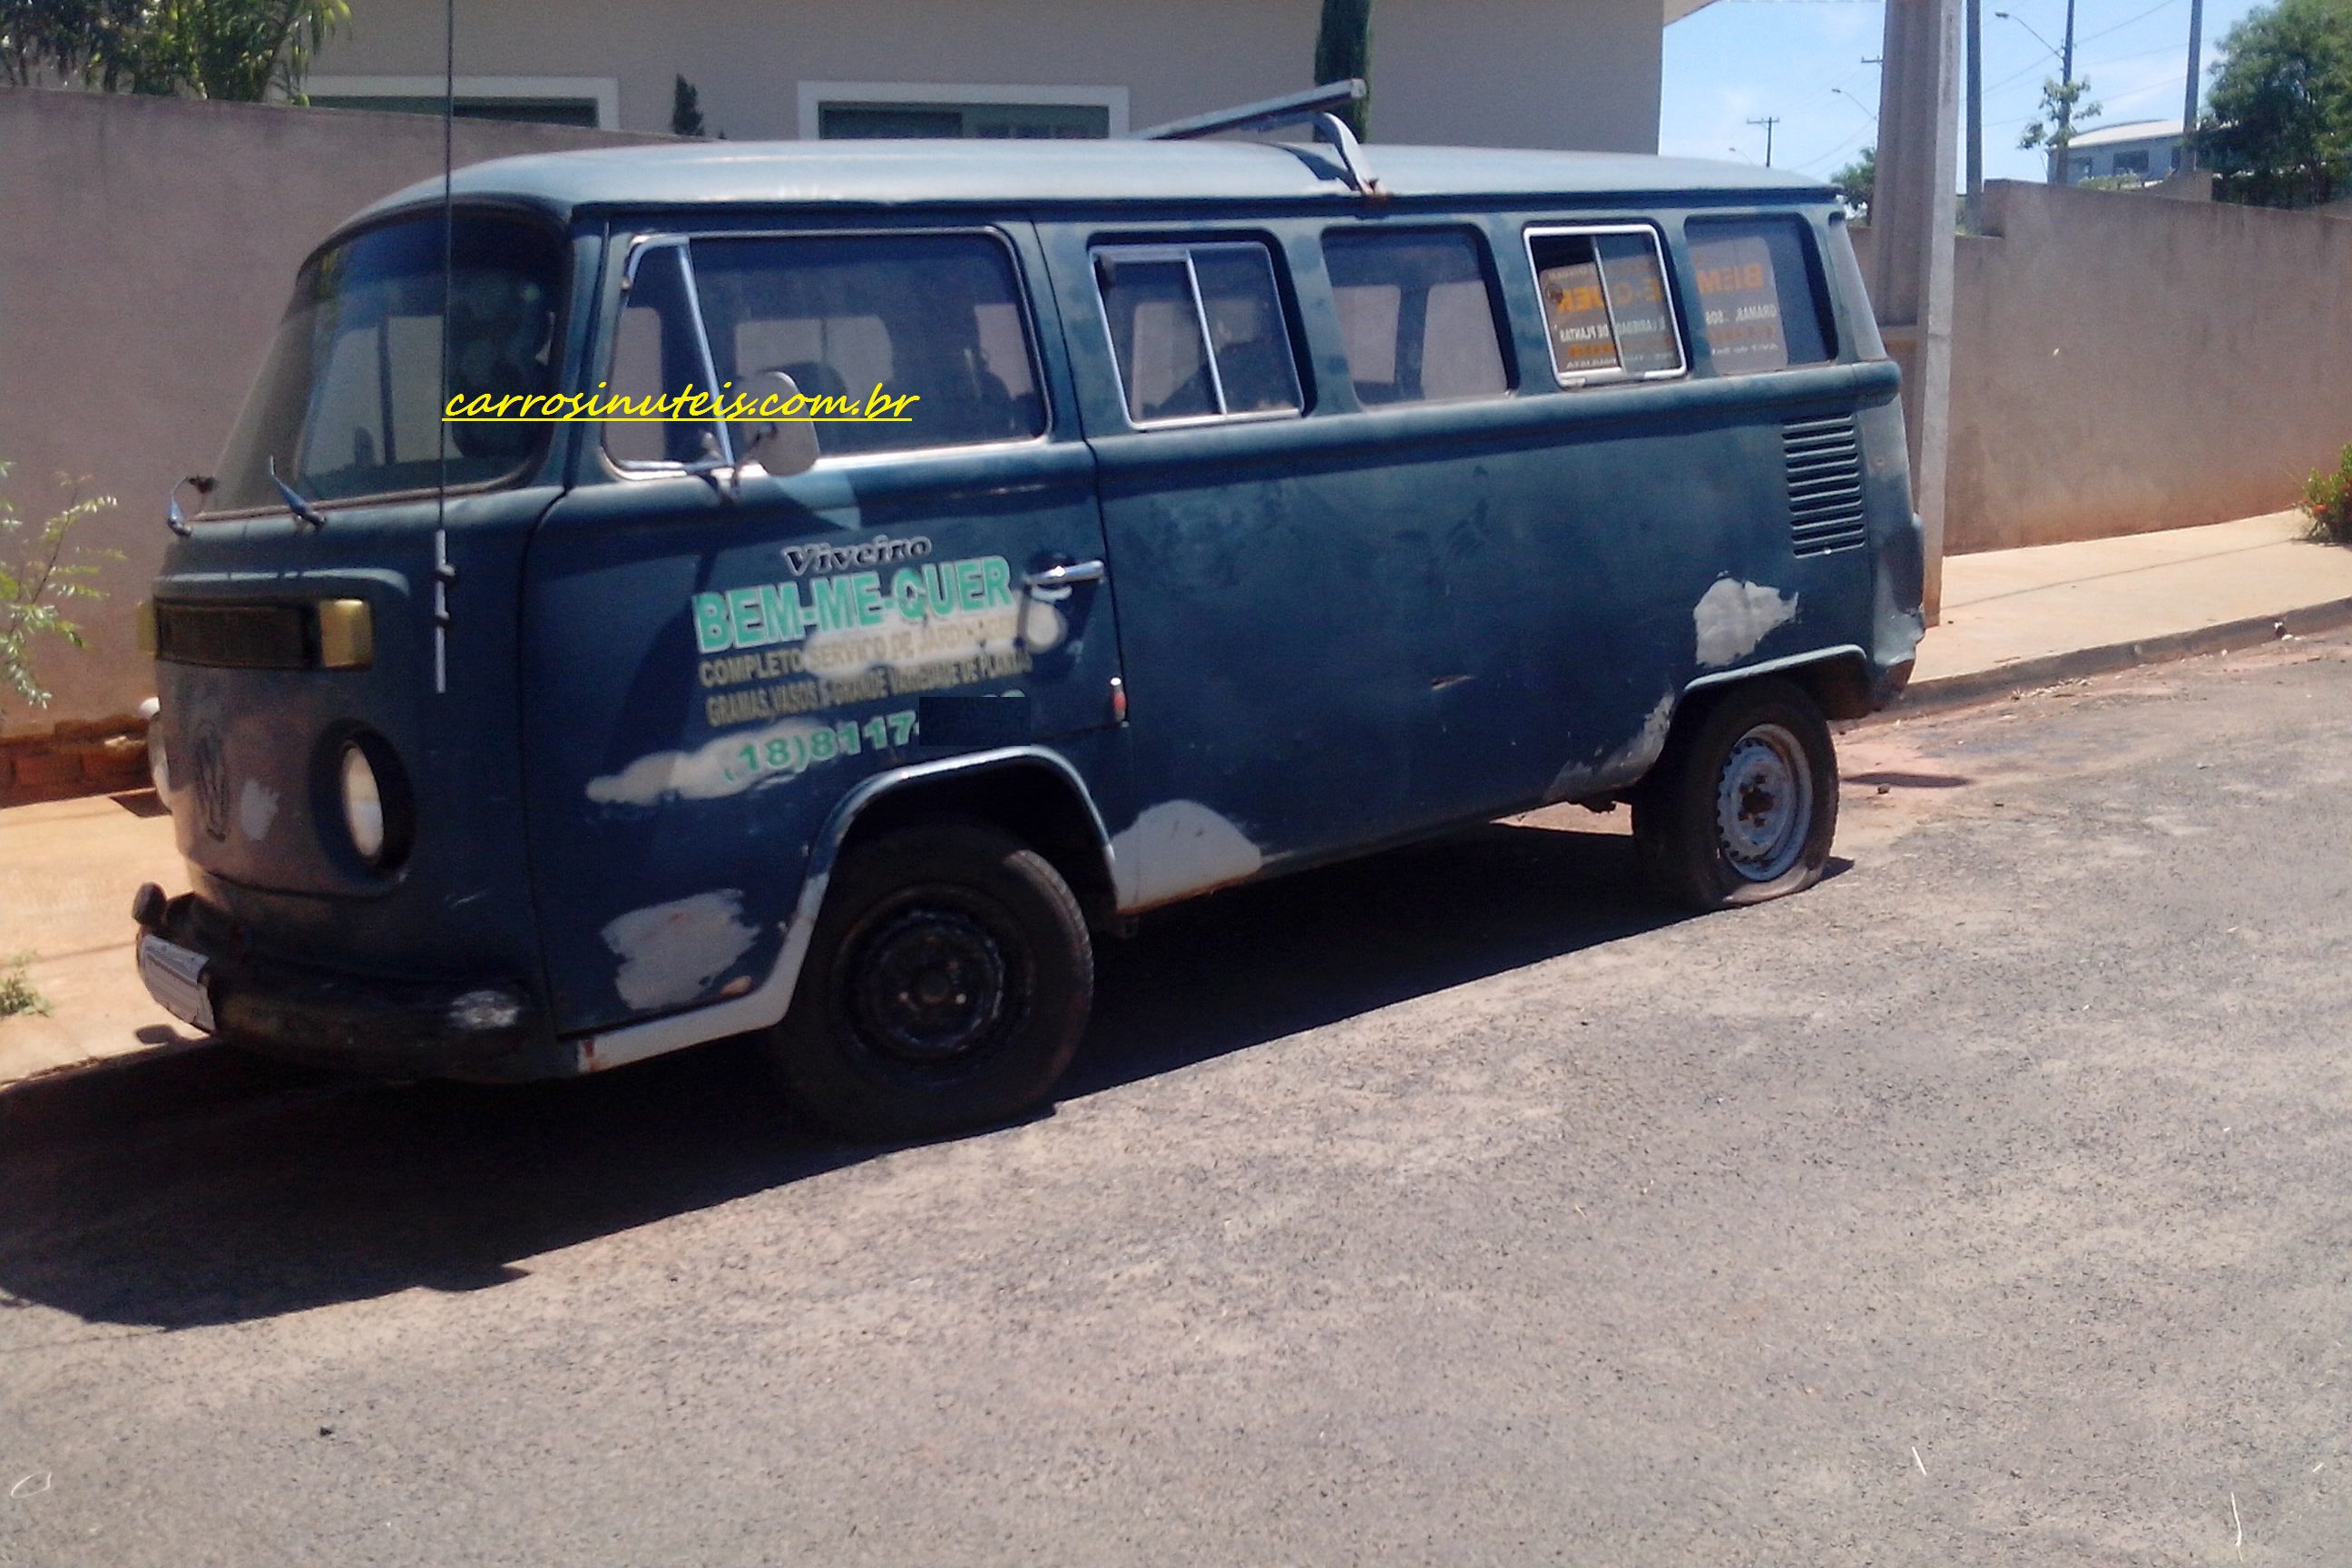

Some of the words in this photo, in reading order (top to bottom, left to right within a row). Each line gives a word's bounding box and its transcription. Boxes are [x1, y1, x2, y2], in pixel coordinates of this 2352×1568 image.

[692, 555, 1014, 654] BEM-ME-QUER
[700, 648, 804, 687] COMPLETO
[724, 710, 919, 784] (18)8117
